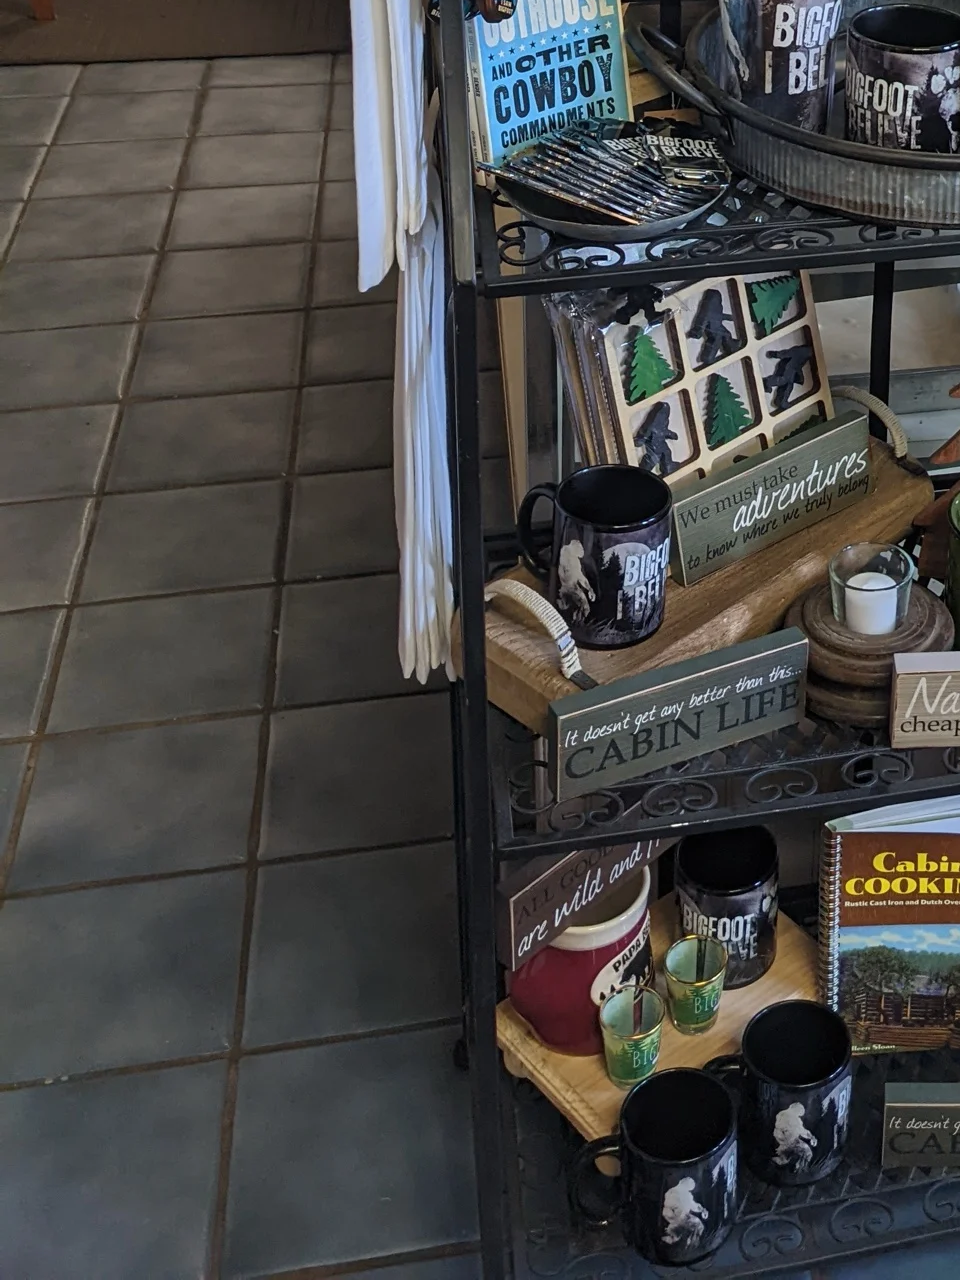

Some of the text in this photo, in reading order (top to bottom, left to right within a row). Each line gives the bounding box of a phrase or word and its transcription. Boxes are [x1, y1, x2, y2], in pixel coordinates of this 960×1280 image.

[492, 33, 610, 82] AND OTHER
[494, 53, 613, 124] COWBOY
[500, 97, 615, 148] COMMANDMENTS
[679, 464, 799, 530] We must take
[687, 474, 869, 570] to know where we truly belong
[732, 447, 869, 533] adventures
[563, 730, 578, 747] It
[635, 710, 655, 734] get
[661, 701, 683, 721] any
[689, 686, 732, 707] better
[735, 676, 763, 694] than
[565, 680, 799, 779] CABIN LIFE
[517, 848, 643, 957] are wild and
